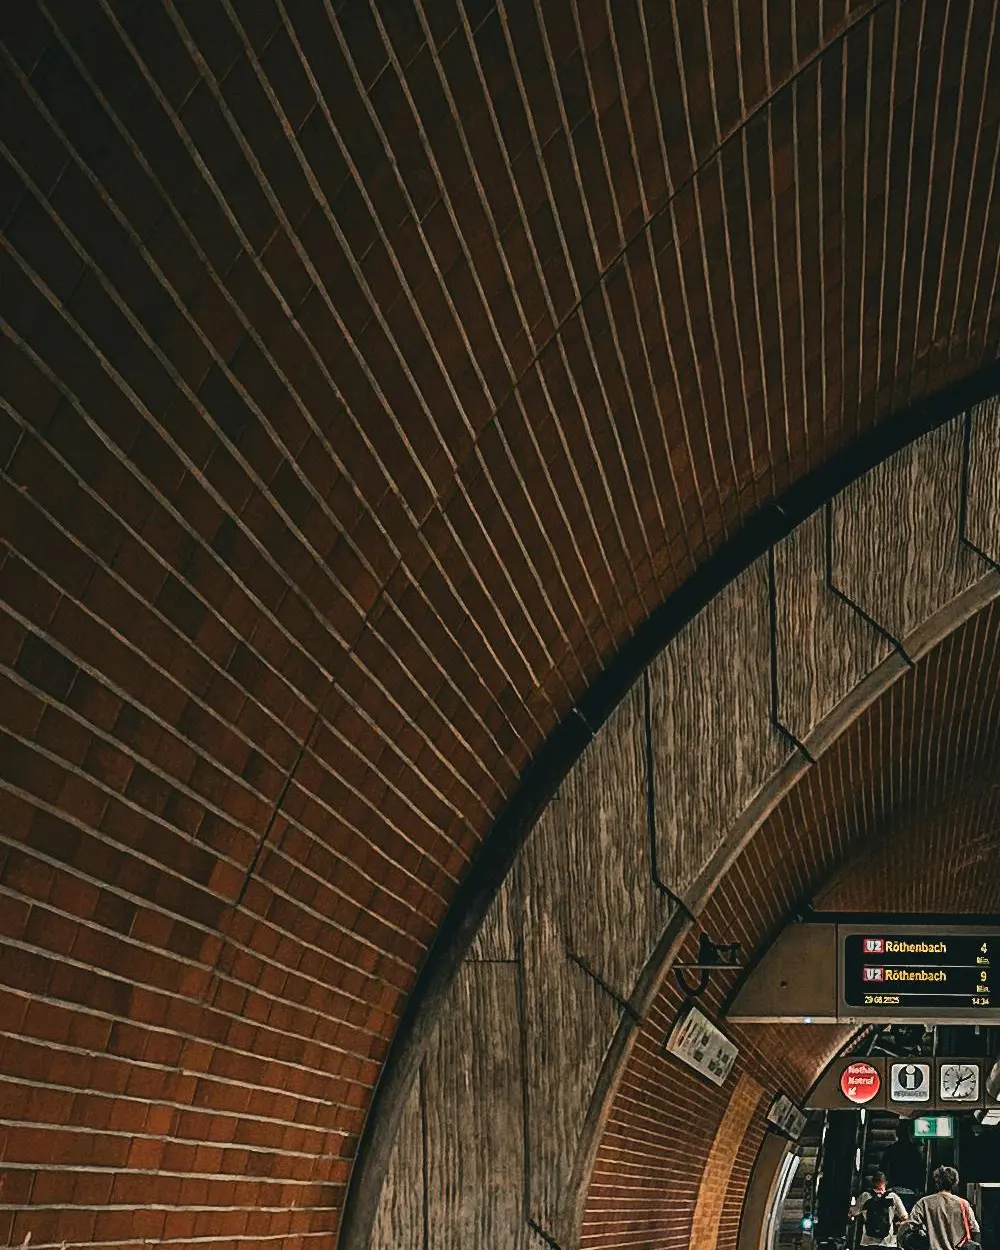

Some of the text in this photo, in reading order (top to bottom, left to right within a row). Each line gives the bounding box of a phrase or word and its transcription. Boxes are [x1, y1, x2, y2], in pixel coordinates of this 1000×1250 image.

[866, 939, 988, 953] U2 Röthenbach 4
[866, 968, 987, 982] U2 Röthenbach 9
